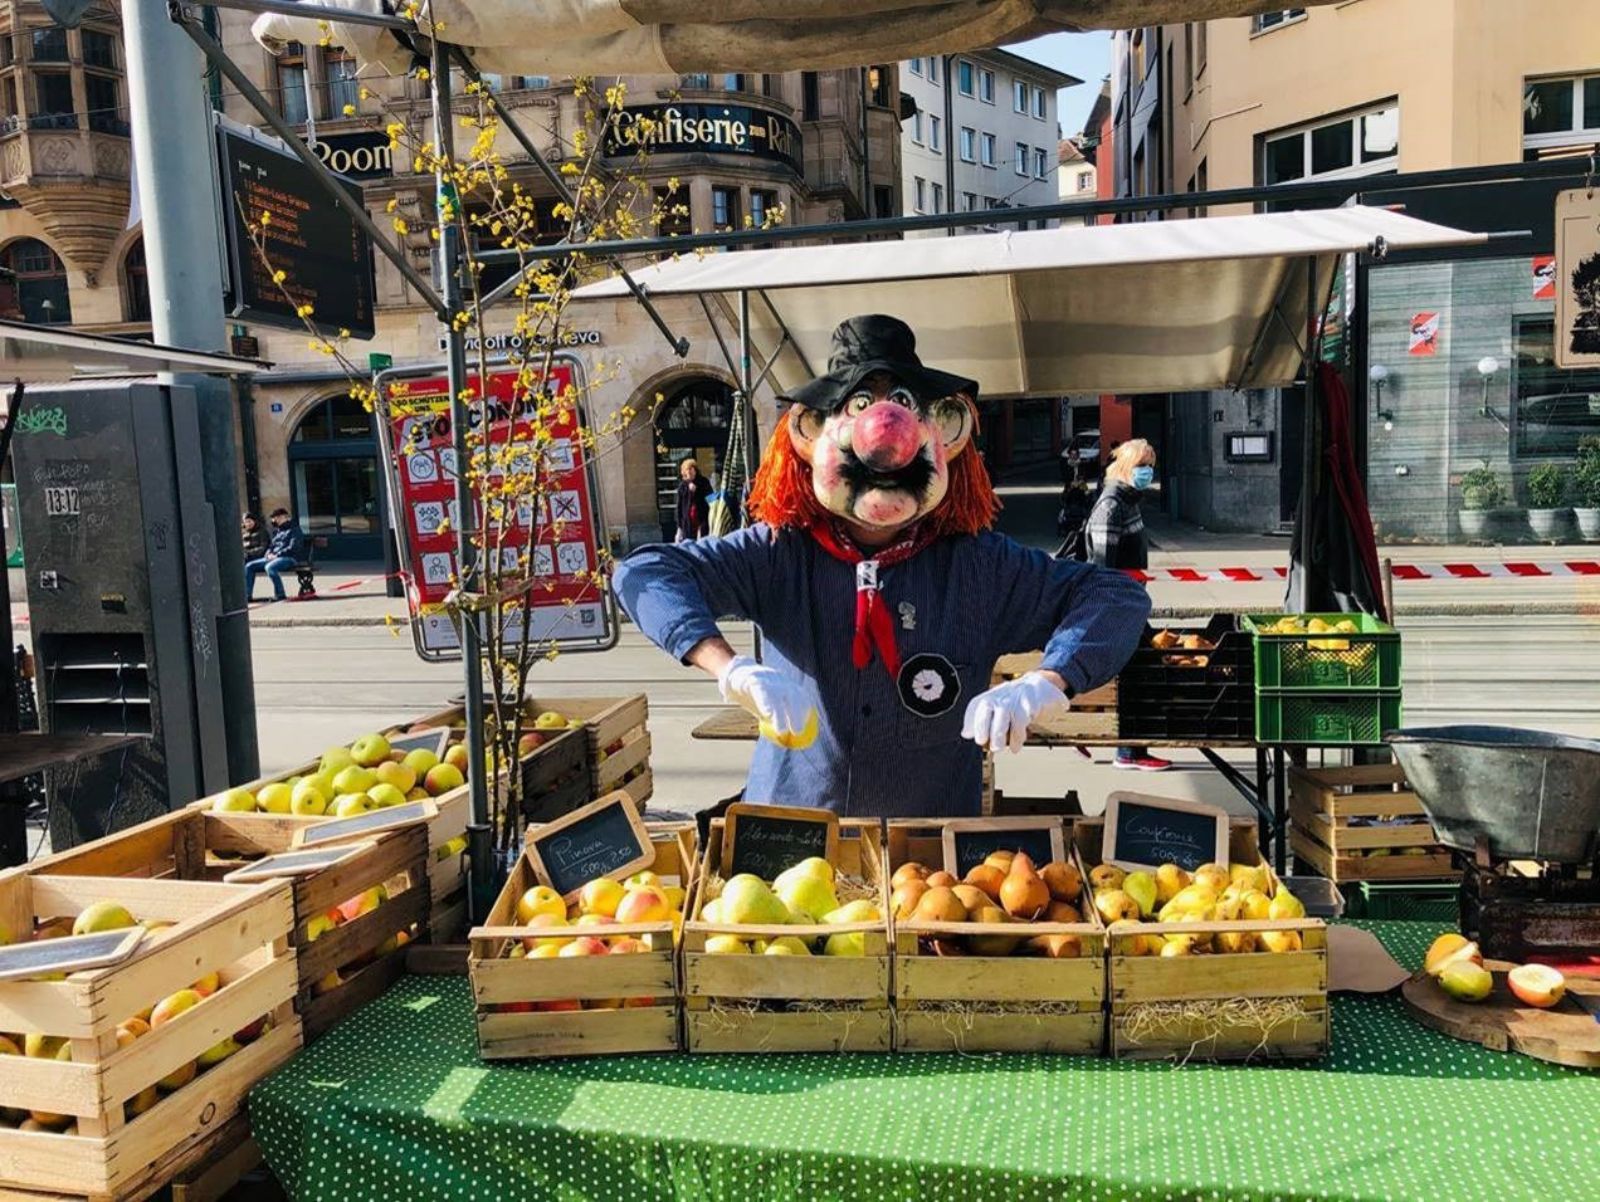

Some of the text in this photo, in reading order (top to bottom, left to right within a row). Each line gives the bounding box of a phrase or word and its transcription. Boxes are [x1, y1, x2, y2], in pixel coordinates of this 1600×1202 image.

[613, 107, 746, 147] Confiserie
[437, 333, 507, 352] Dvidoff
[410, 414, 451, 443] STO
[48, 489, 80, 513] 13:12
